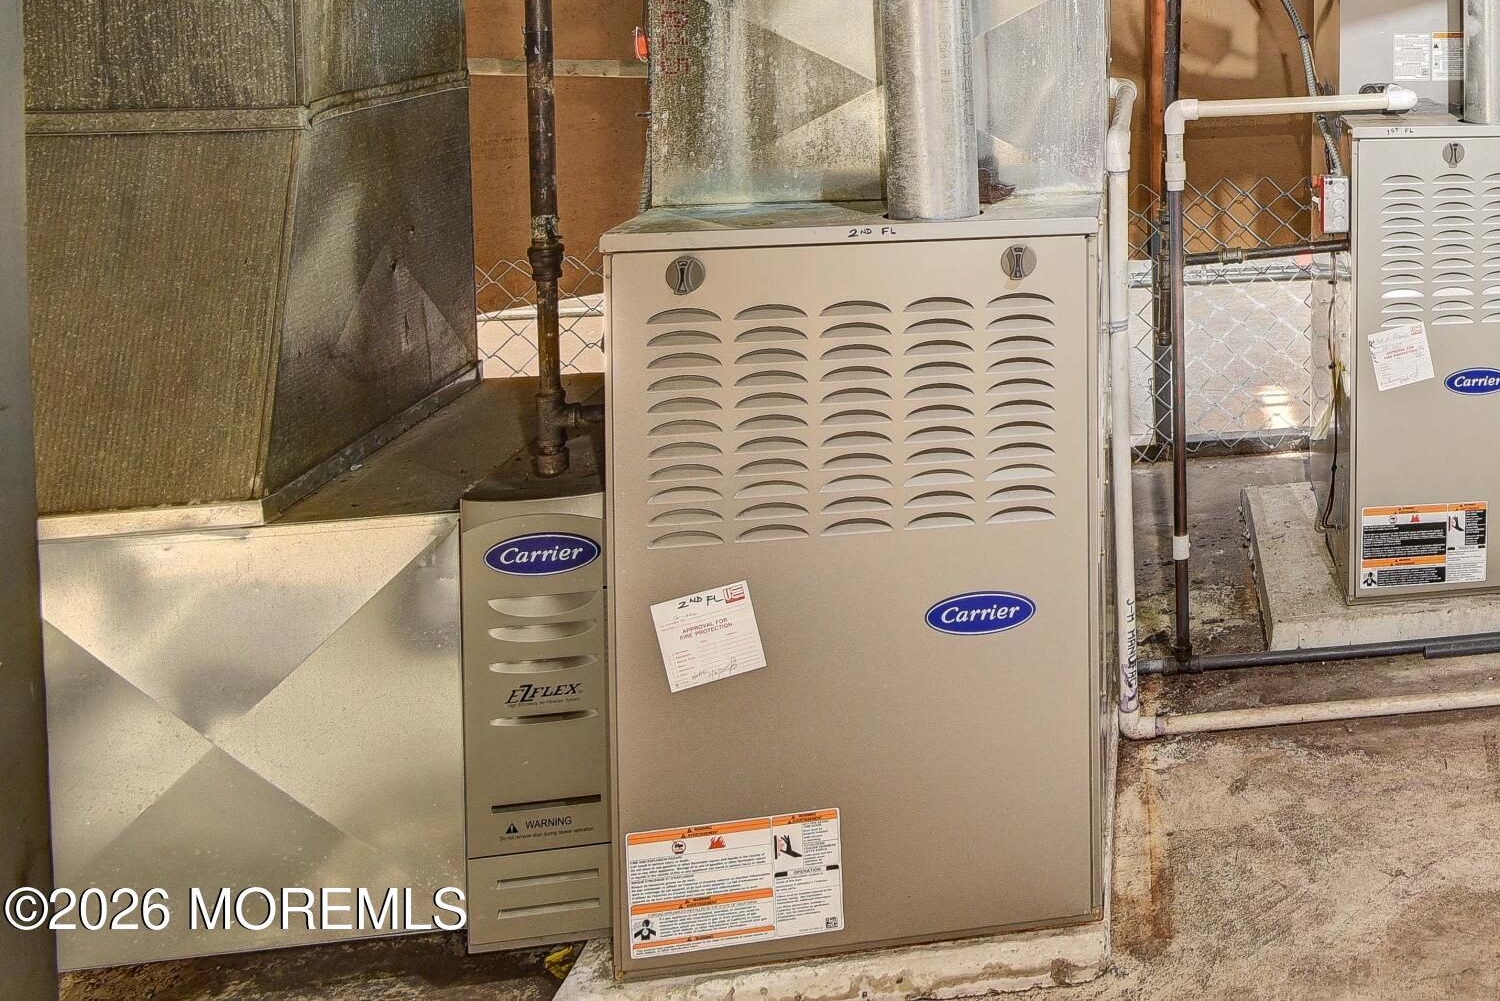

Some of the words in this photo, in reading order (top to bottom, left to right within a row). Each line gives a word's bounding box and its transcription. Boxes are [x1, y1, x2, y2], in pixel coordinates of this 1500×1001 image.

[847, 227, 873, 238] 2ND
[881, 226, 897, 236] FL
[500, 545, 583, 565] Carrier
[677, 596, 703, 609] 2ND
[706, 594, 724, 607] FL
[940, 604, 1021, 625] Carrier
[680, 632, 694, 640] FIRE
[695, 622, 733, 637] PROTECTION
[682, 622, 715, 634] APPROVAL
[715, 617, 728, 626] FOR
[504, 683, 581, 705] EZFLEX
[525, 816, 572, 829] WARNING
